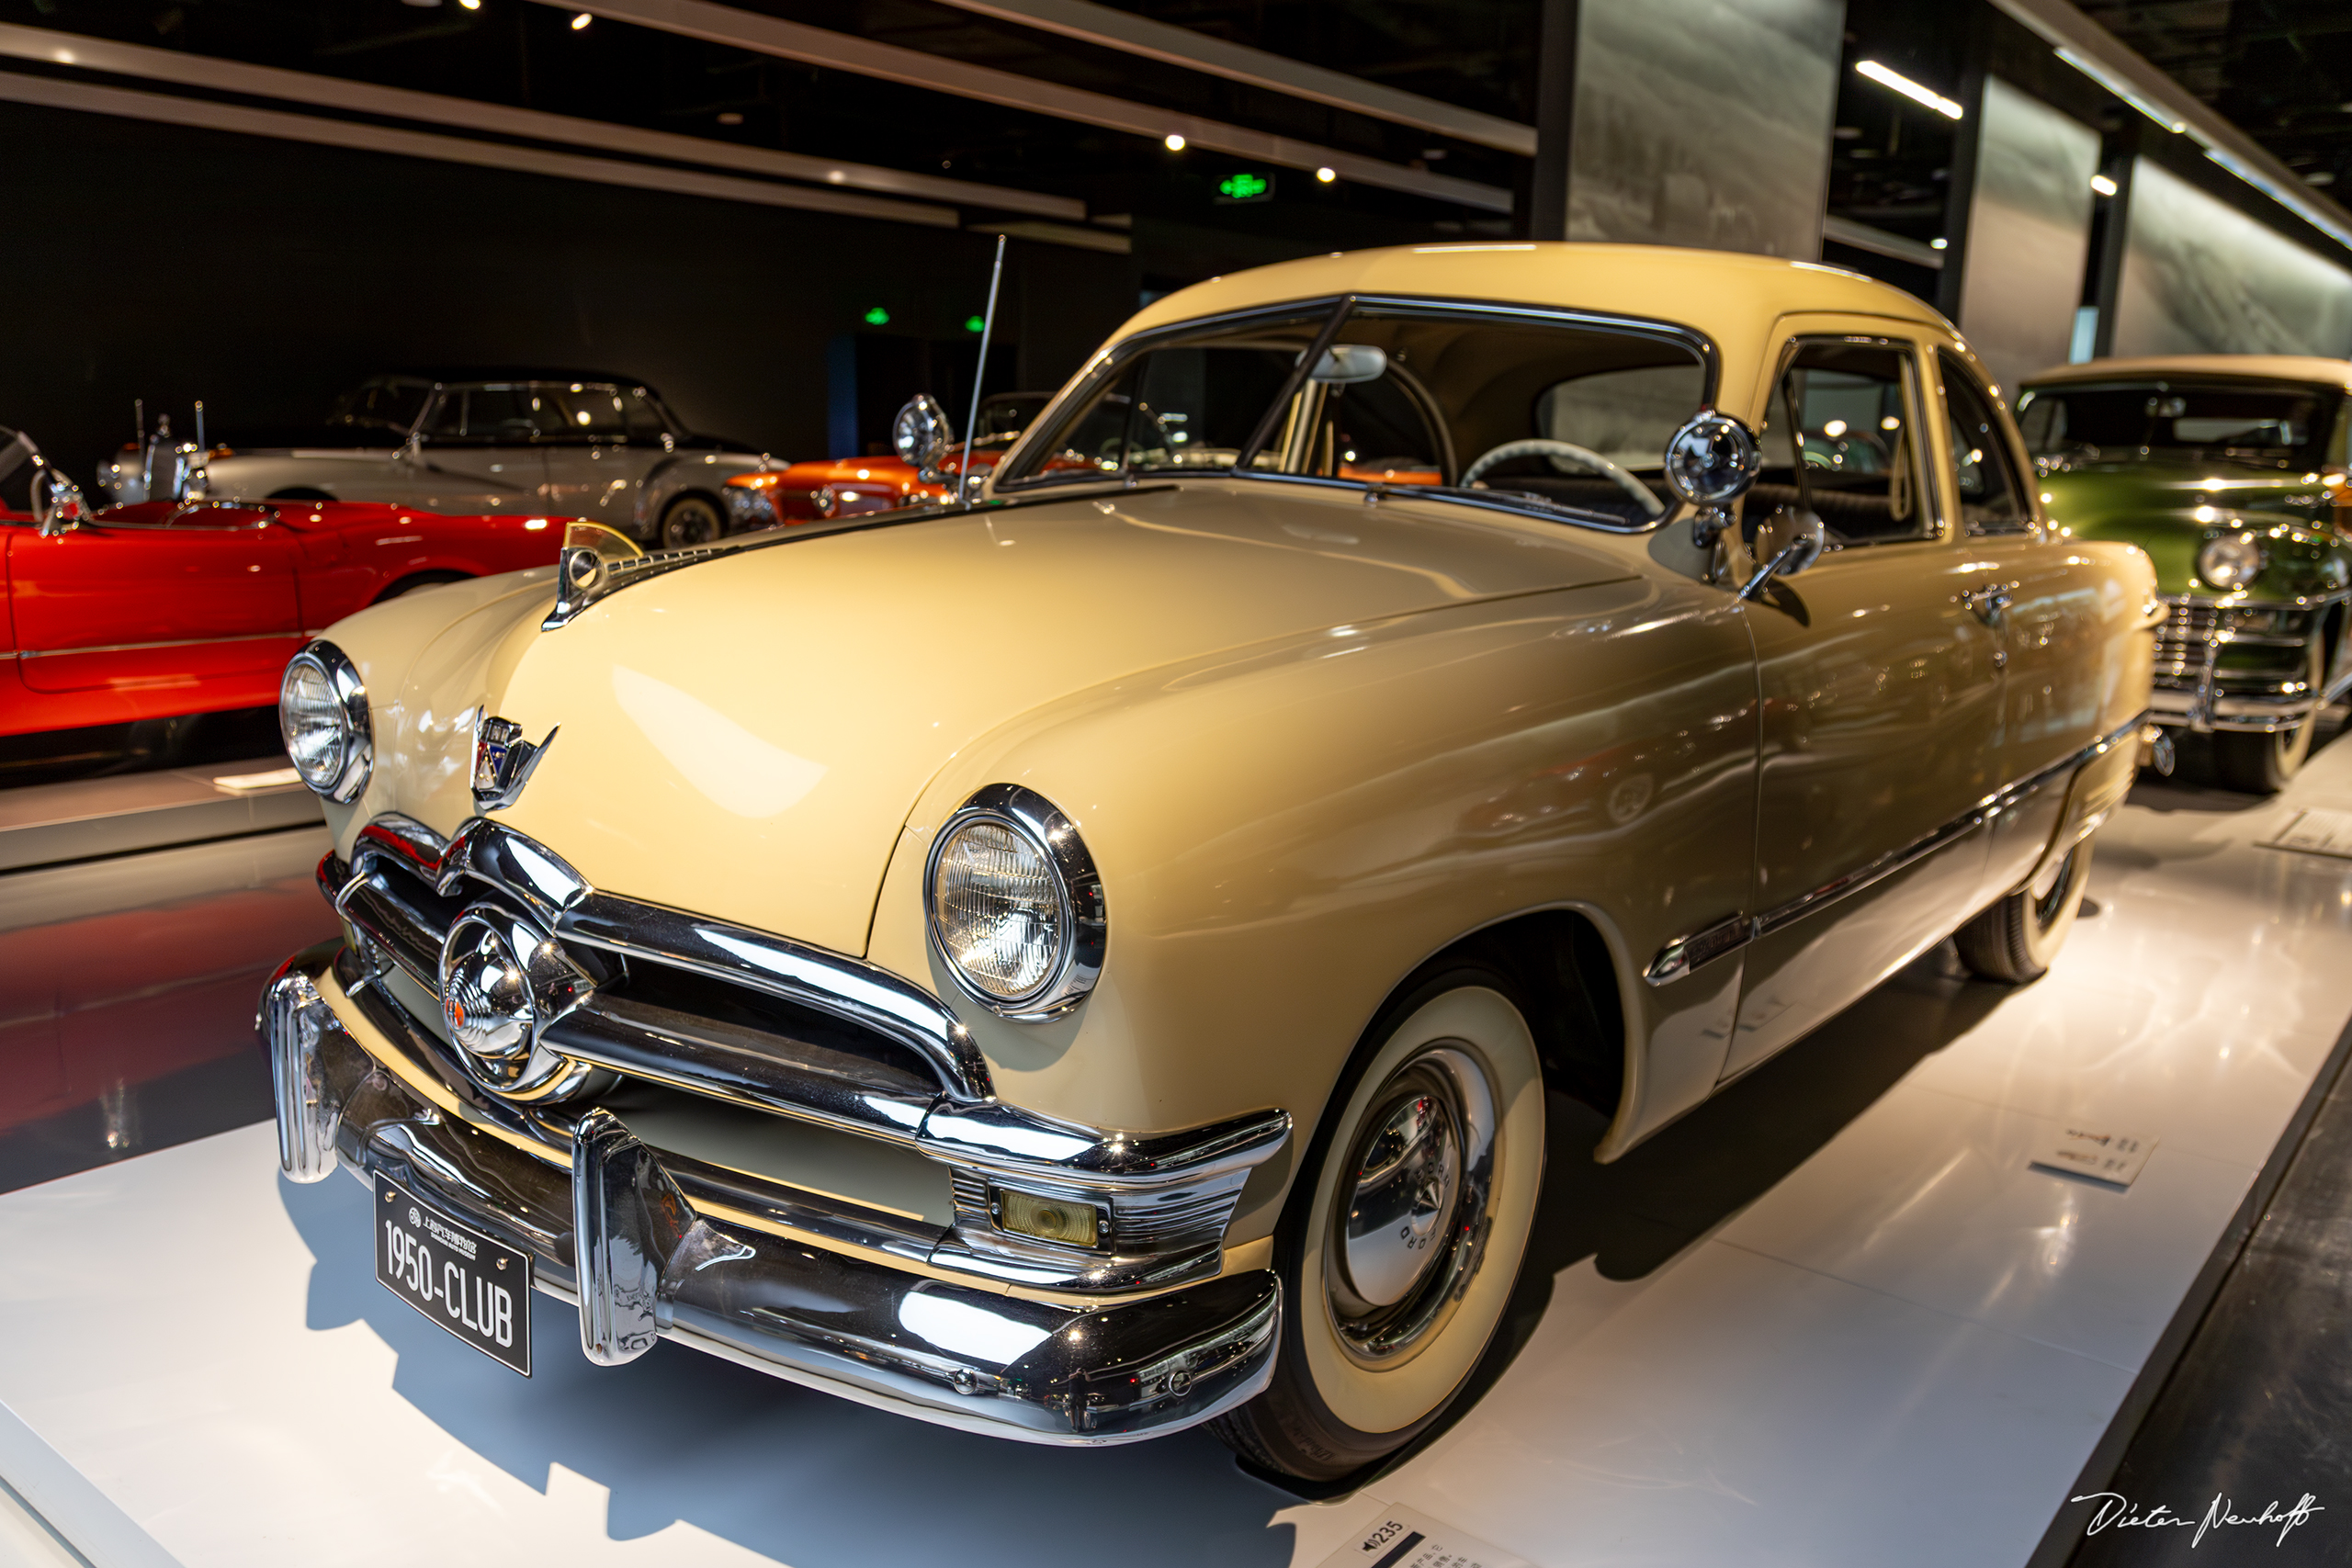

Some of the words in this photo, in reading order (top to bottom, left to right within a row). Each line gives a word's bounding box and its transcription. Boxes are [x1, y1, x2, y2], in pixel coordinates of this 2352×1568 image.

[1414, 1162, 1450, 1190] FORD
[1400, 1225, 1437, 1250] FORD
[385, 1219, 513, 1348] 1950-CLUB
[1372, 1520, 1404, 1544] 235
